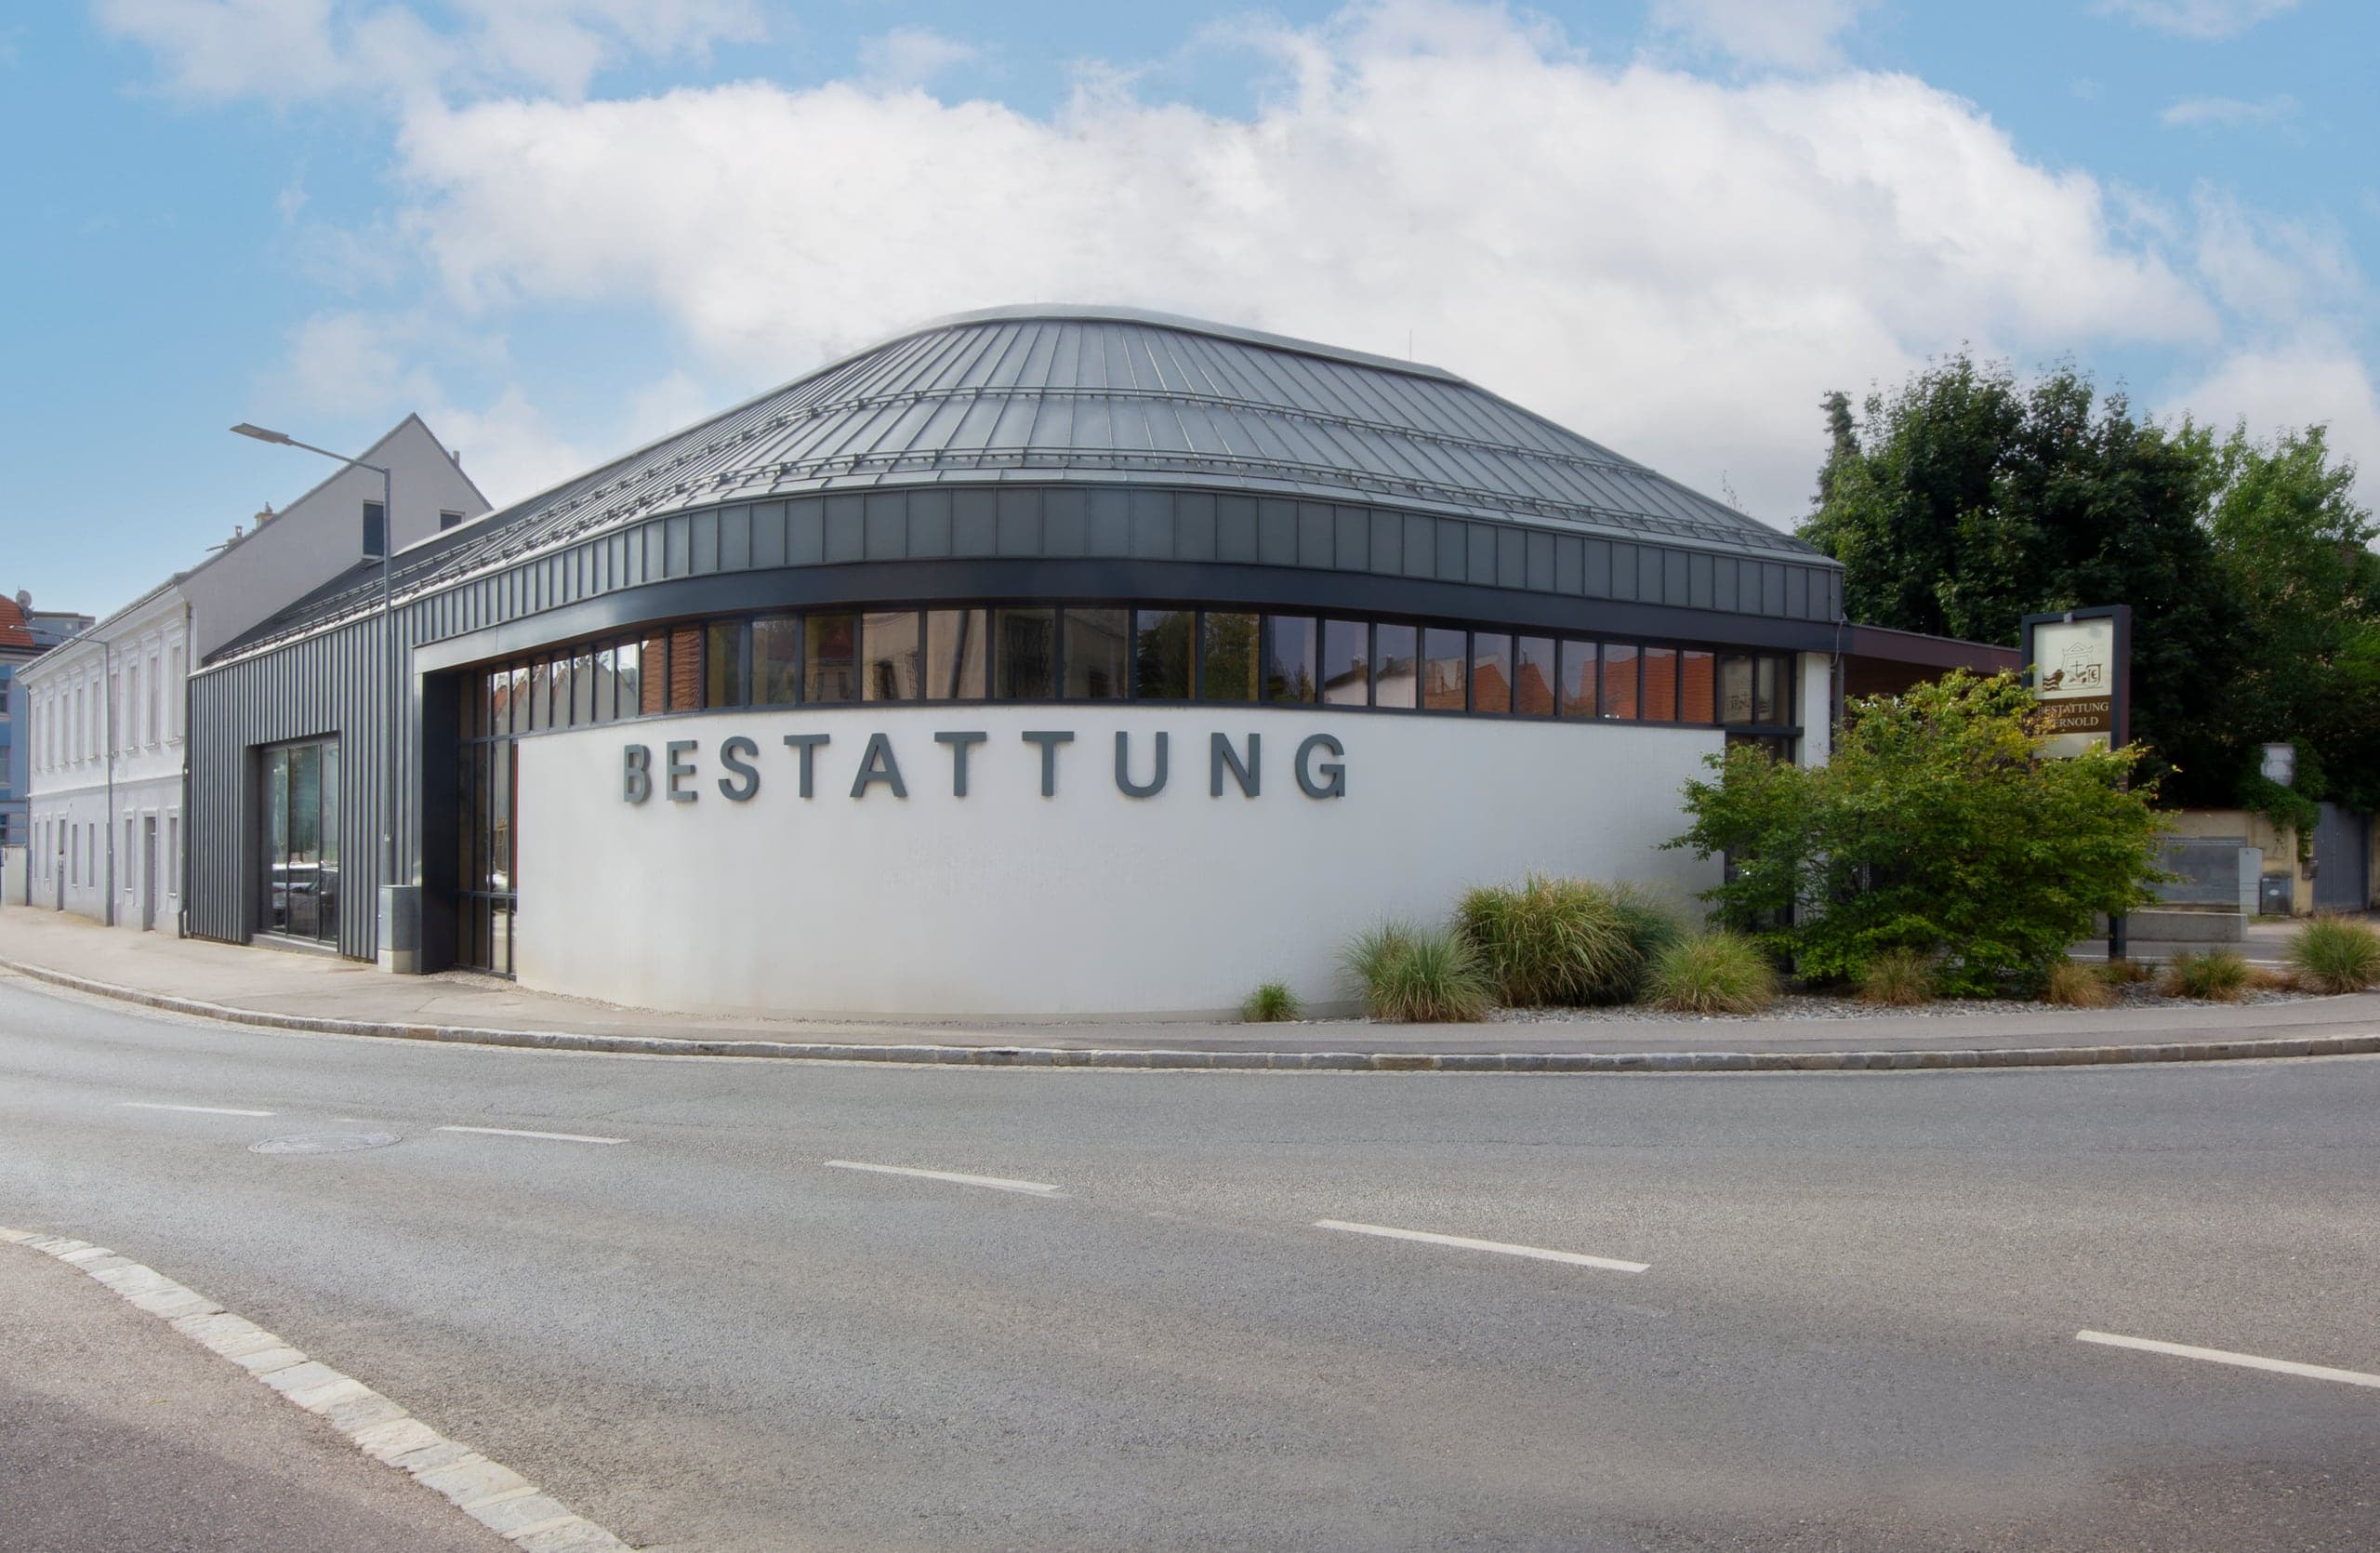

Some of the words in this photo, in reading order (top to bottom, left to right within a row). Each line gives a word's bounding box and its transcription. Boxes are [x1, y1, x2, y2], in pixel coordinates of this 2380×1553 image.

[2037, 702, 2109, 715] BESTATTUNG
[2048, 716, 2099, 729] ERNOLD
[623, 731, 1346, 803] BESTATTUNG
